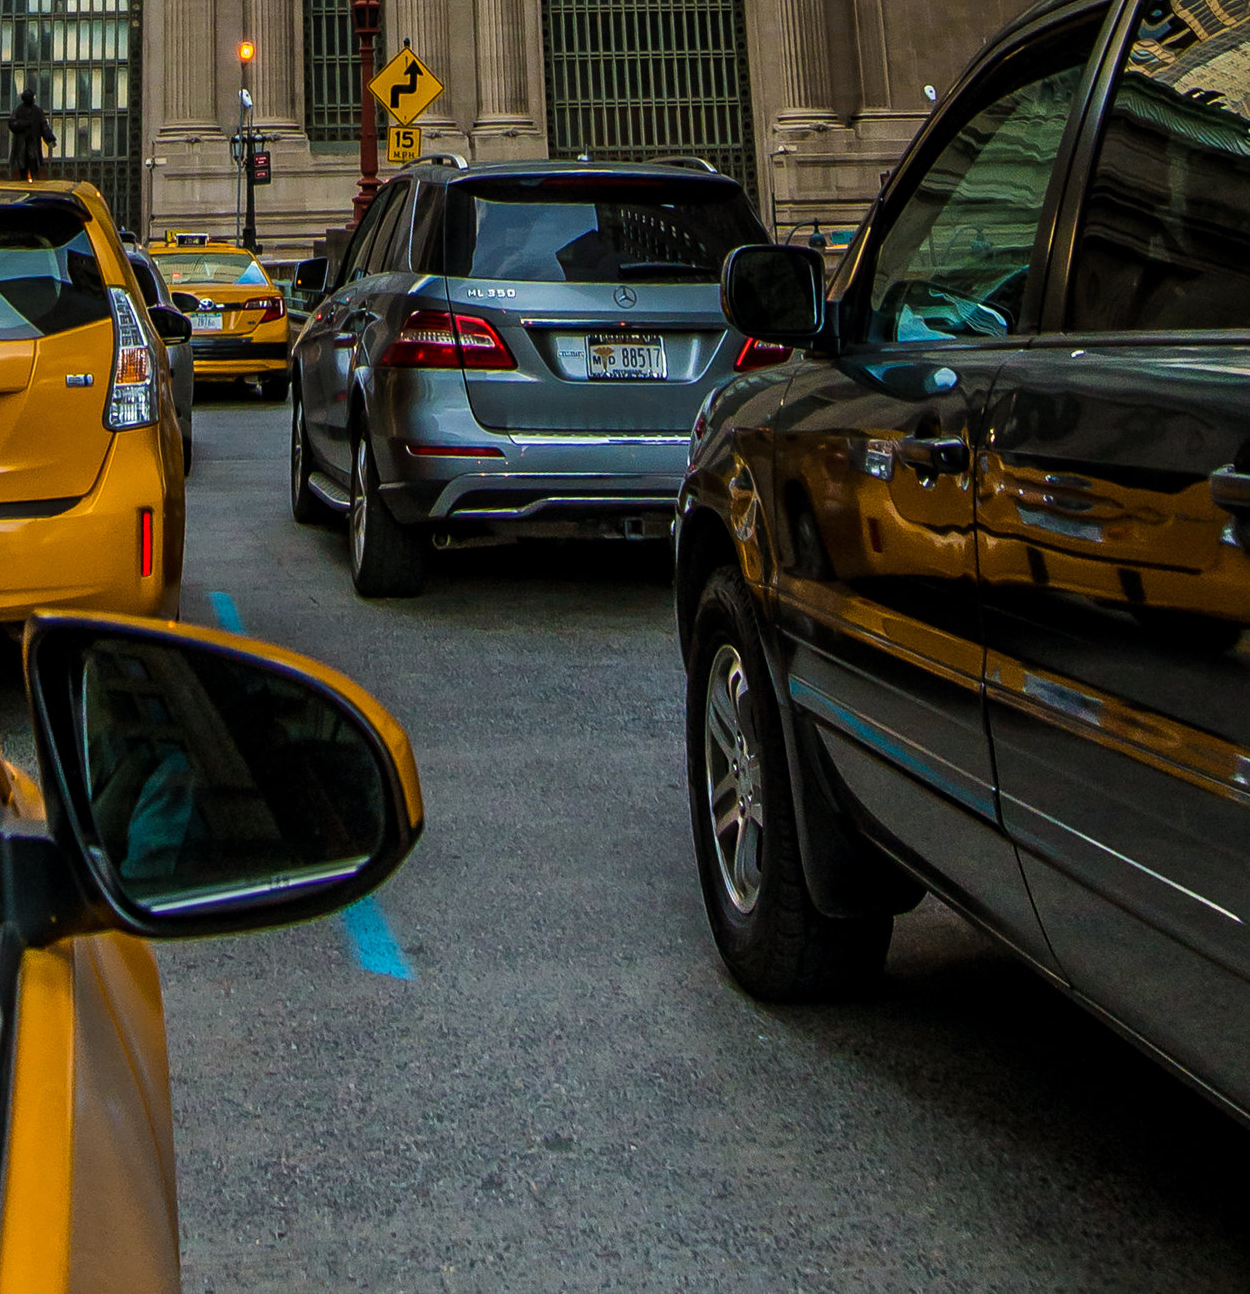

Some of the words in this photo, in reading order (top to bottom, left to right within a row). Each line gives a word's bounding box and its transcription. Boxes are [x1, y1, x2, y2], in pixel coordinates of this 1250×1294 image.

[395, 130, 415, 149] 15
[467, 289, 485, 298] ML
[487, 289, 516, 298] 350
[621, 347, 661, 368] 88517
